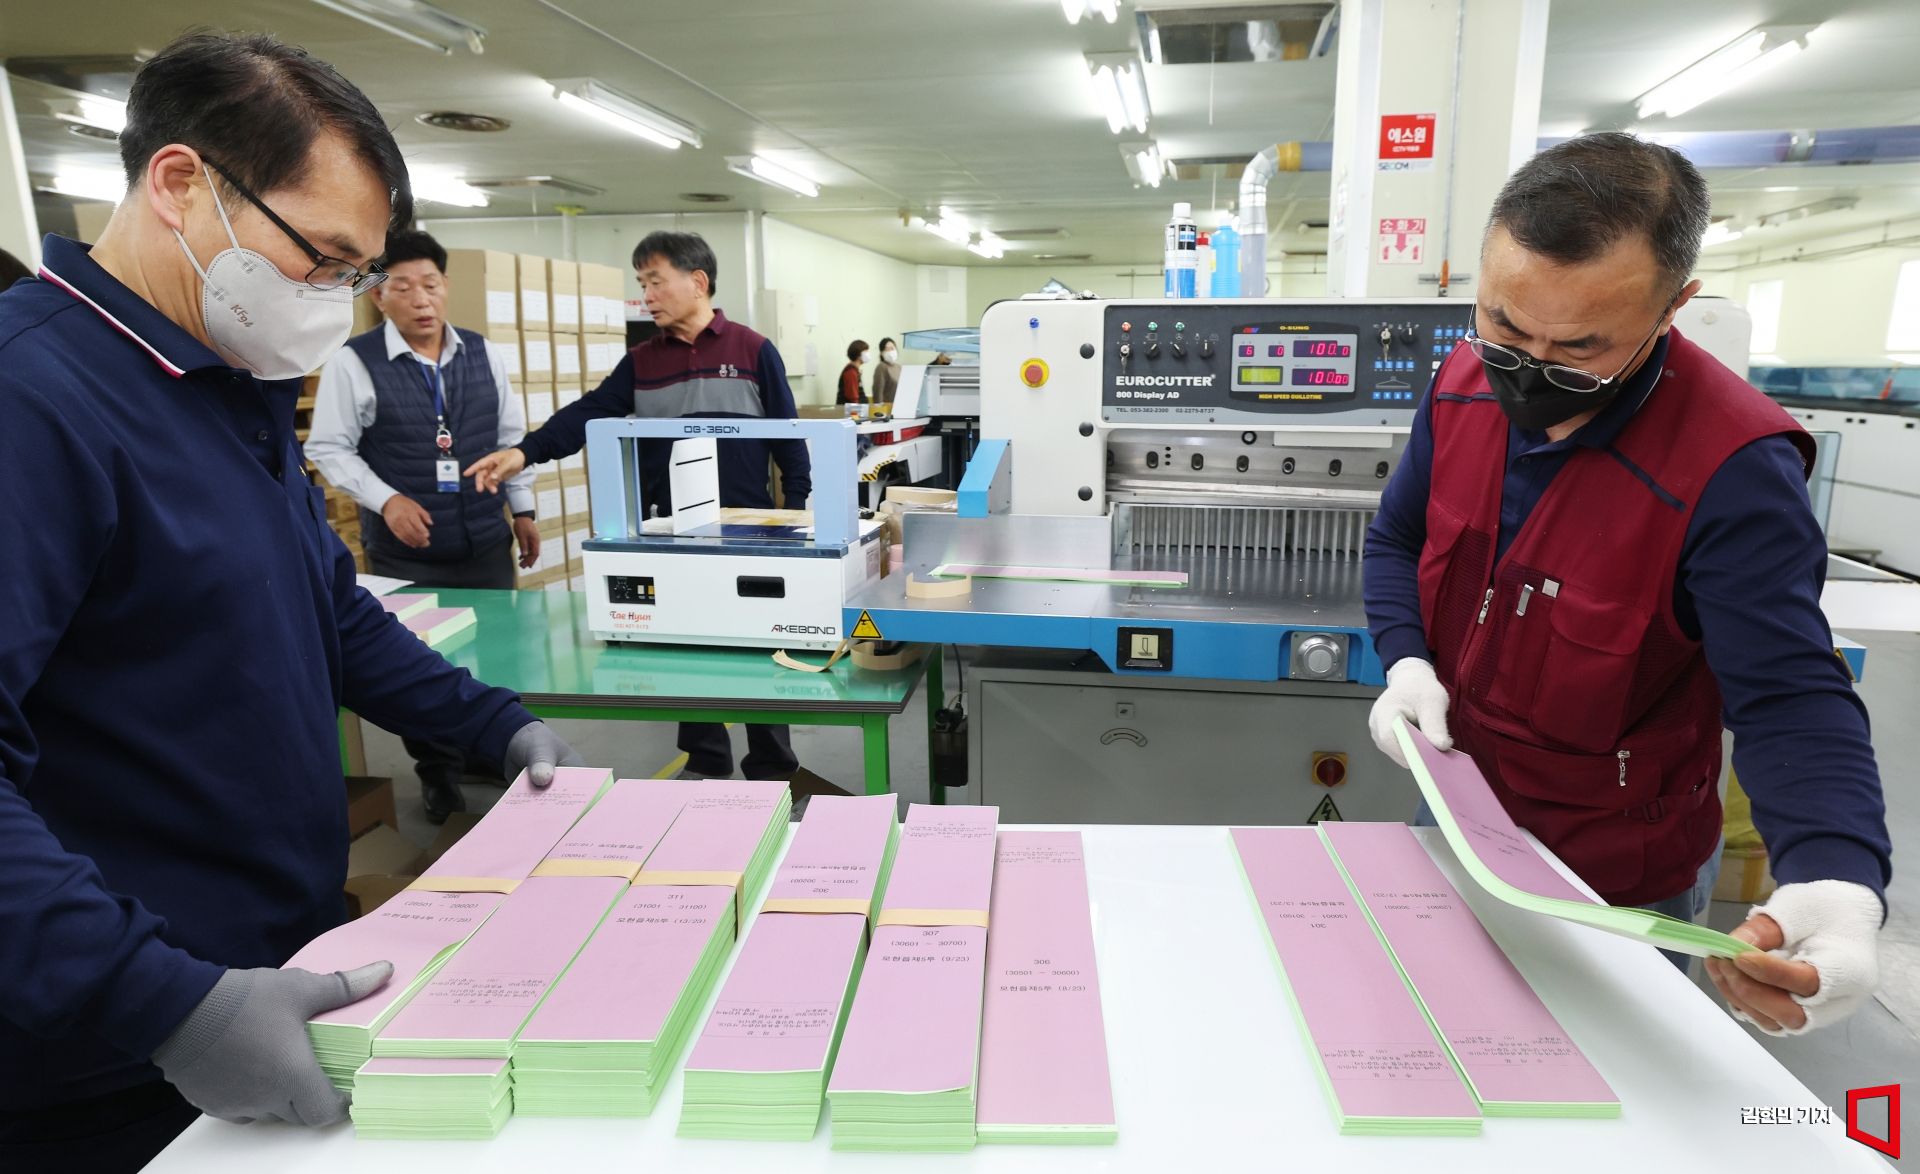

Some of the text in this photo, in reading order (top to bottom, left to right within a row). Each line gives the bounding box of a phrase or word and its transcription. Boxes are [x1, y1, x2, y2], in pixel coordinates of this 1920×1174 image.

[1388, 126, 1426, 144] 에스원
[230, 304, 254, 328] KF94
[1246, 346, 1253, 355] 6
[1276, 346, 1284, 356] 0
[1134, 391, 1164, 400] Display
[628, 612, 651, 622] Hyun
[771, 624, 836, 636] AKEBONO
